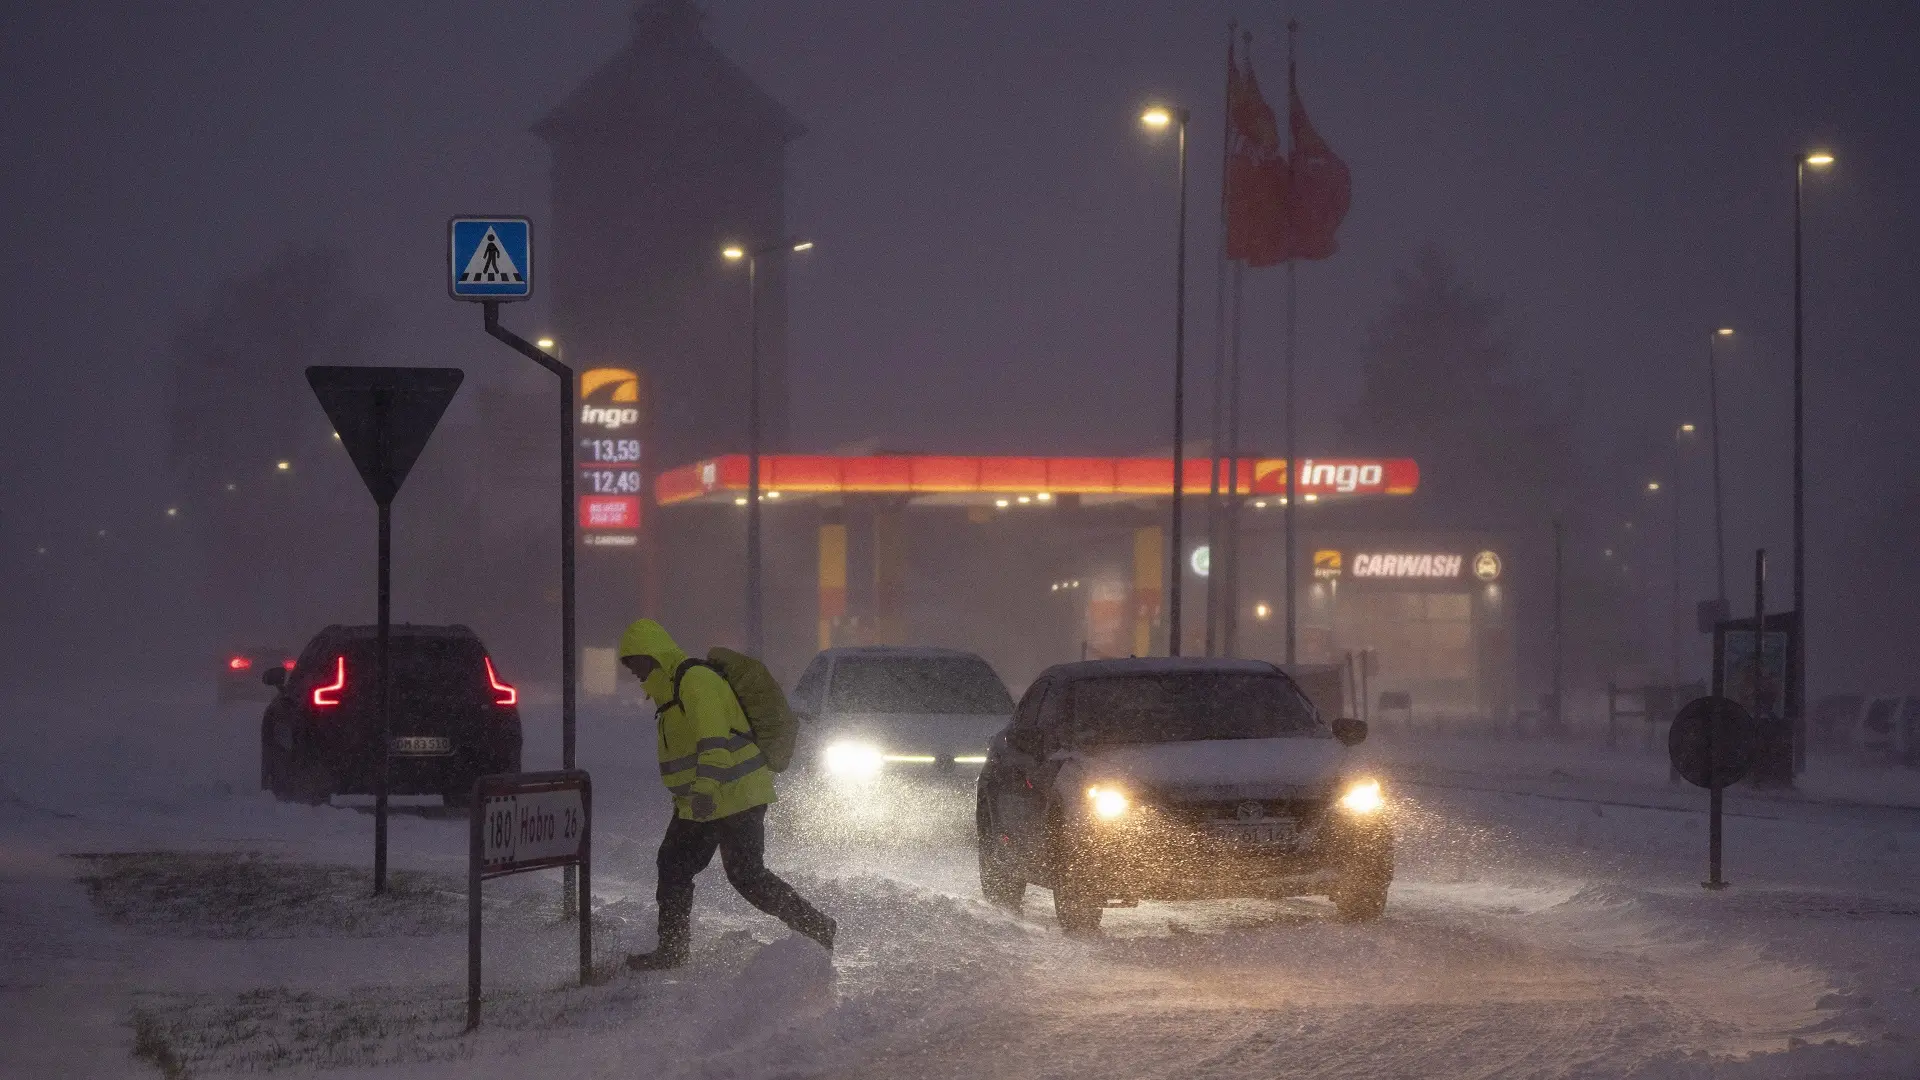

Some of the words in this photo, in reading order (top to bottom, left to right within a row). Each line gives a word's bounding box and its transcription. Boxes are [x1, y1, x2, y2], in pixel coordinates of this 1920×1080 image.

[581, 405, 638, 428] ingo
[593, 440, 640, 461] 13,59
[593, 471, 640, 493] 12,49
[1301, 459, 1382, 492] ingo
[1352, 553, 1462, 577] CARWASH
[490, 811, 512, 849] 180
[520, 806, 556, 845] Hobro
[564, 808, 578, 838] 26
